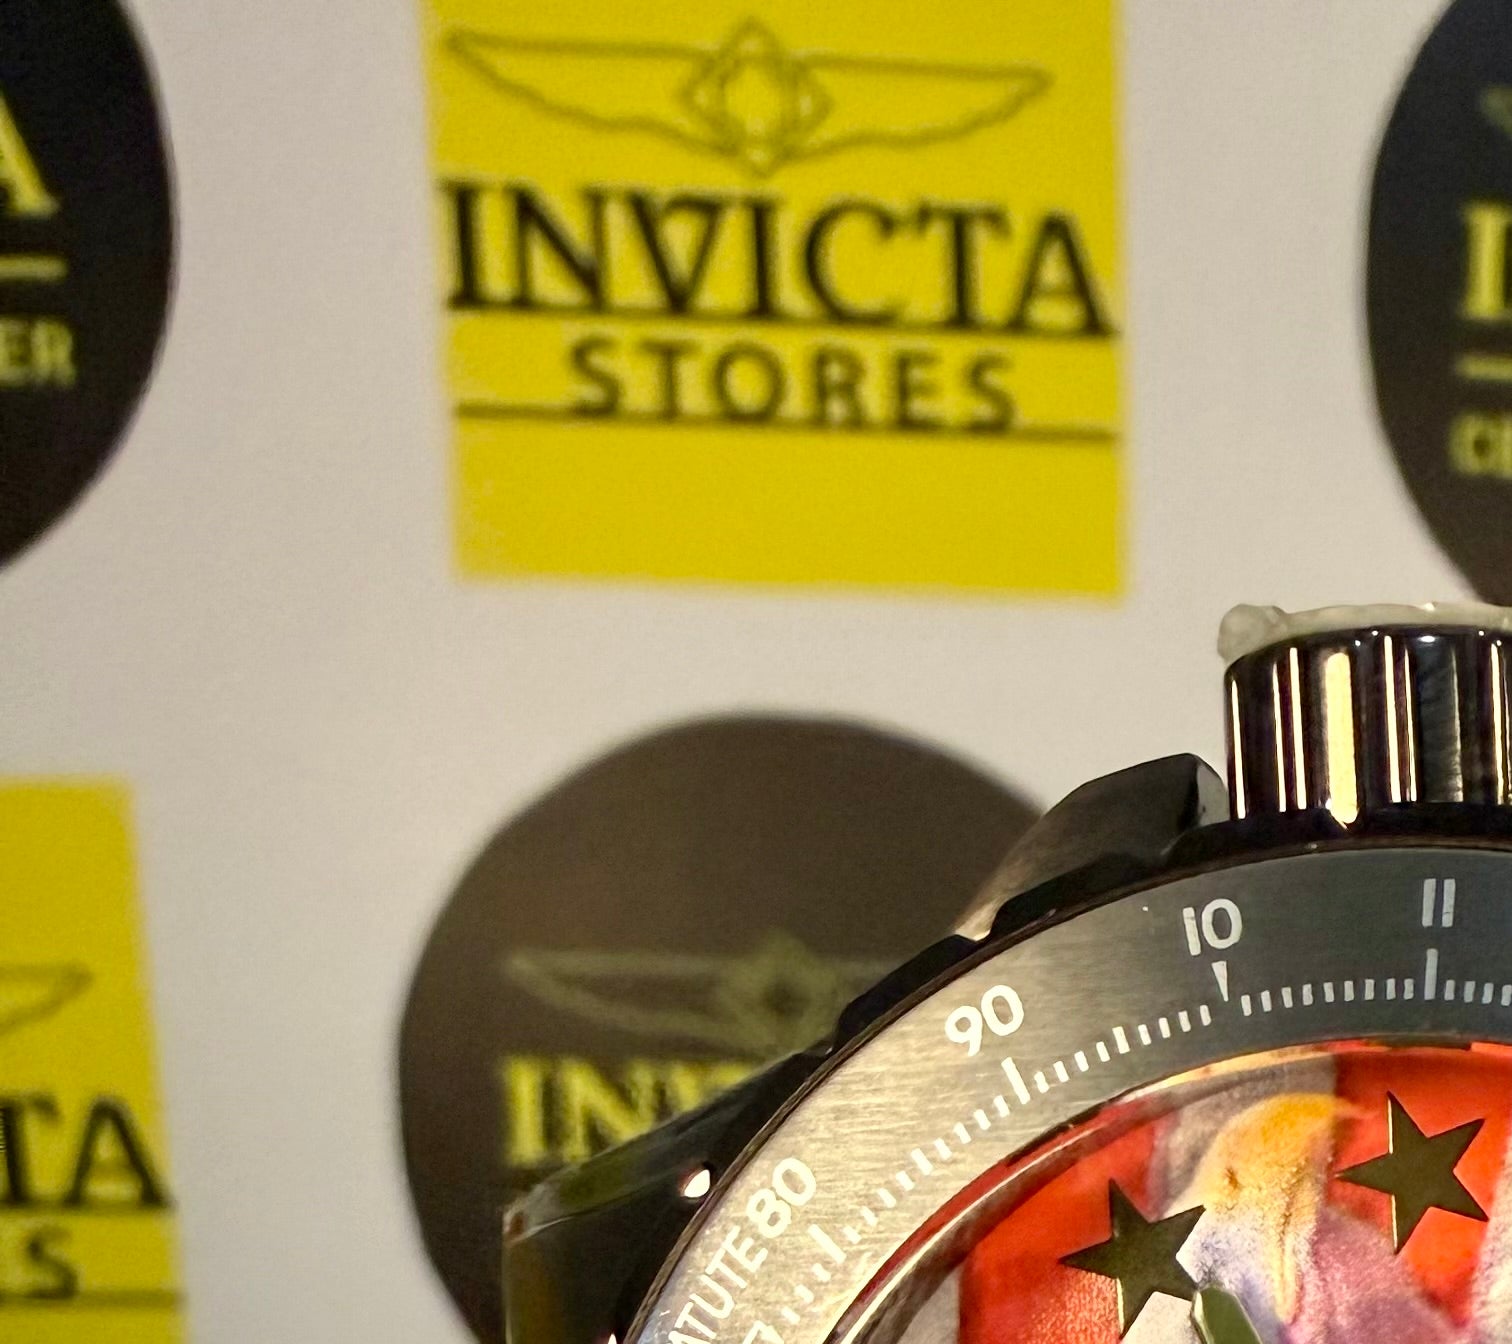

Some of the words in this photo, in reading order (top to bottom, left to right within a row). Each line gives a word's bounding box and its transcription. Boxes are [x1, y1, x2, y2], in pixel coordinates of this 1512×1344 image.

[439, 178, 1117, 335] INVICTA
[568, 335, 1019, 433] STORES
[1182, 898, 1242, 956] 10
[1422, 878, 1455, 928] 11
[944, 985, 1024, 1056] 90
[746, 1157, 816, 1238] 80
